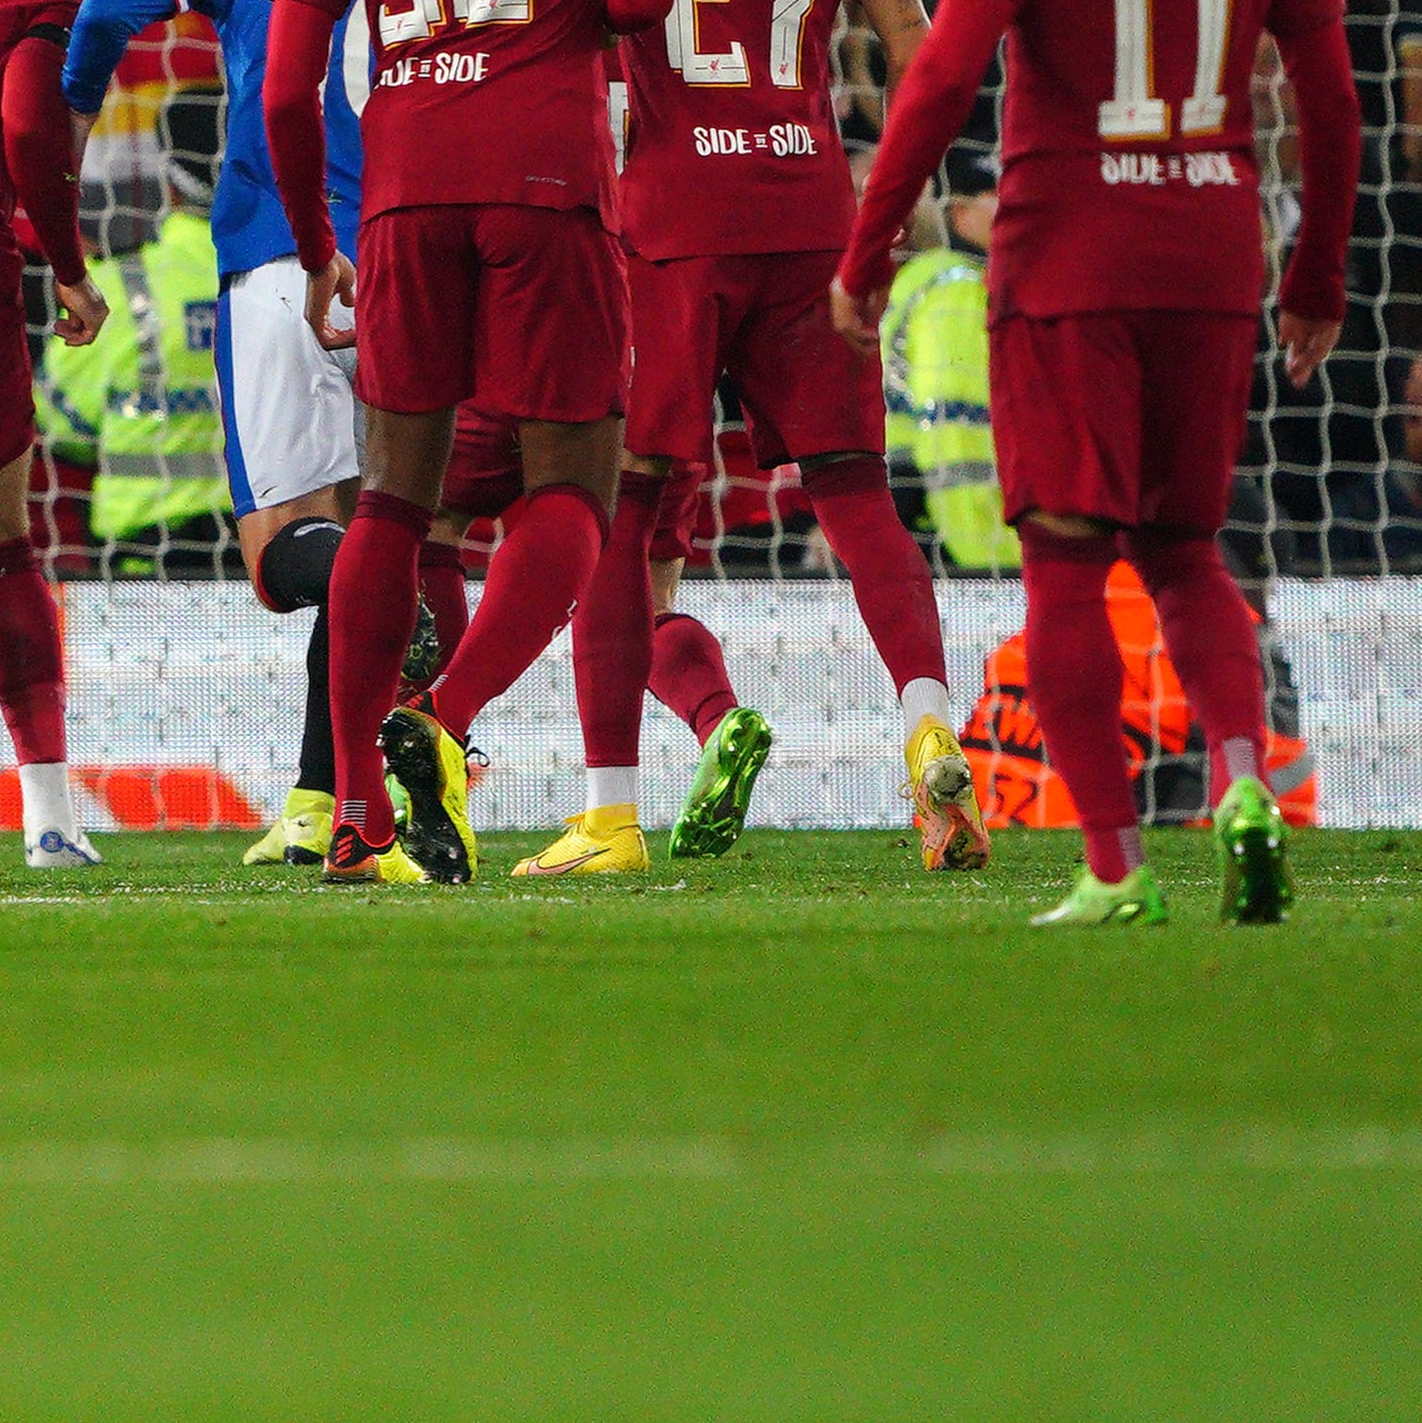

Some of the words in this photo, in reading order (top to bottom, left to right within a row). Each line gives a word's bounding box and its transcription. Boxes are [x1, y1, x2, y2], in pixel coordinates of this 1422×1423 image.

[435, 52, 491, 85] SIDE
[692, 127, 751, 156] SIDE
[768, 123, 818, 157] SIDE
